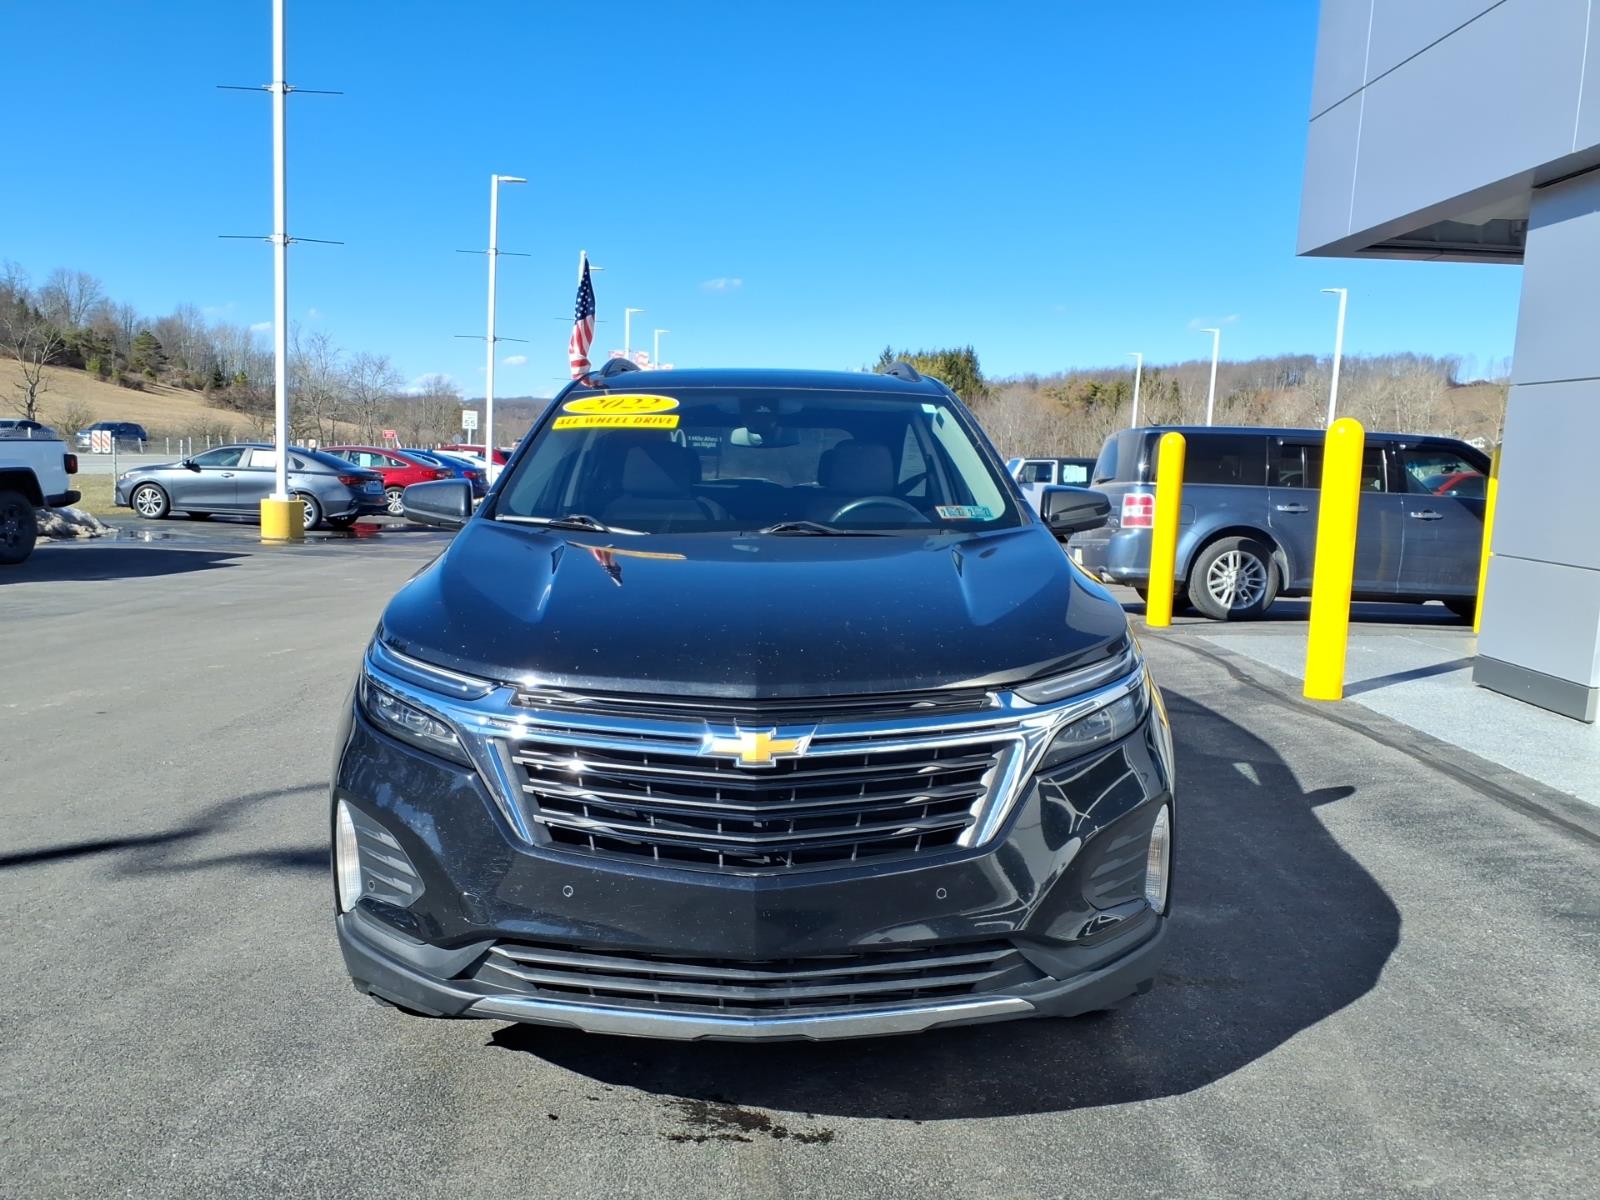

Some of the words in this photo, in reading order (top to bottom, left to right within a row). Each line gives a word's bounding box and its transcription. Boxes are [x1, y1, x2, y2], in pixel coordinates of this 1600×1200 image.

[464, 419, 476, 427] 55
[557, 417, 579, 426] ALL
[585, 416, 629, 425] WHEEL
[633, 416, 673, 424] DRIVE
